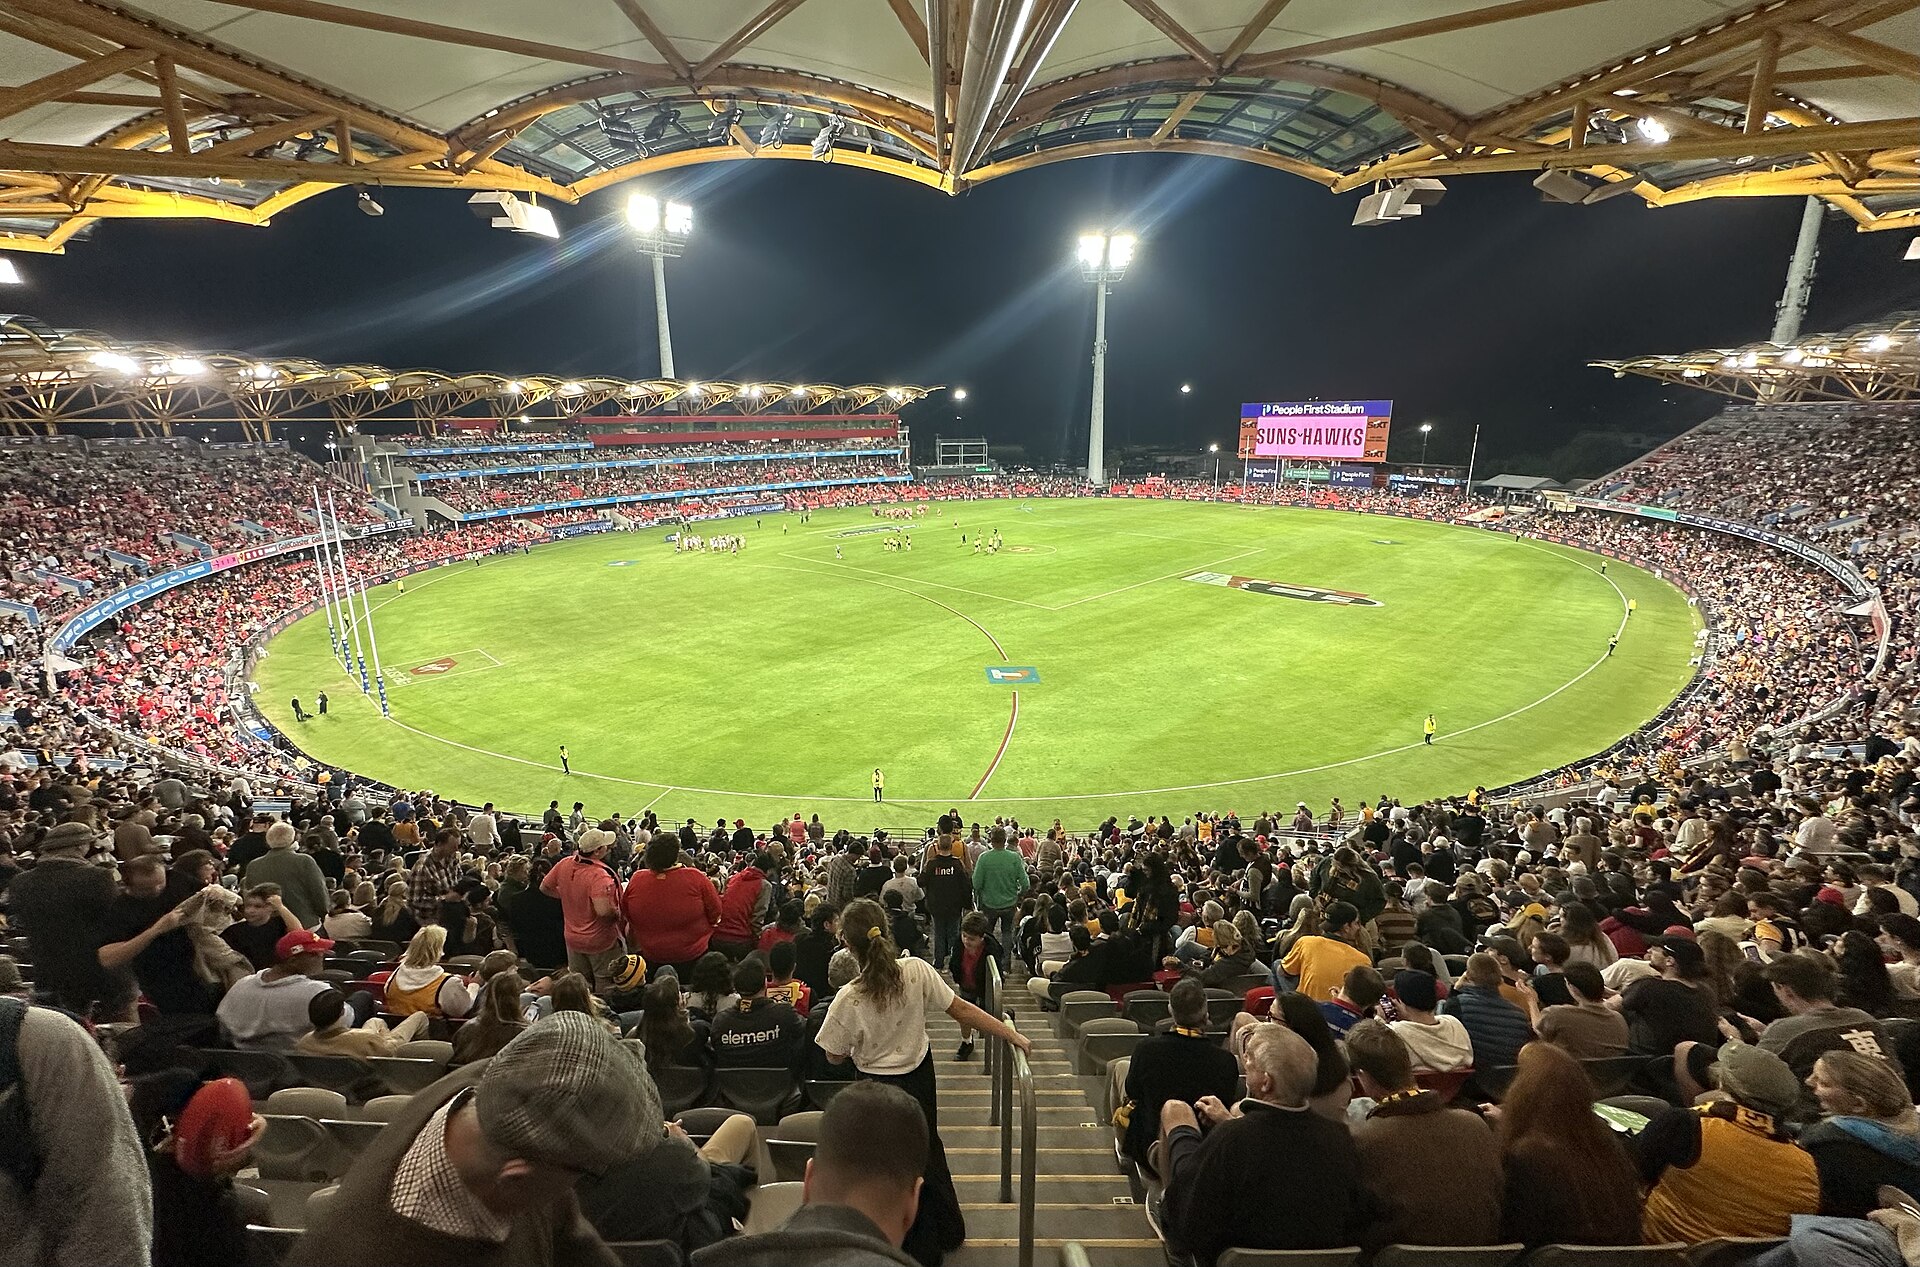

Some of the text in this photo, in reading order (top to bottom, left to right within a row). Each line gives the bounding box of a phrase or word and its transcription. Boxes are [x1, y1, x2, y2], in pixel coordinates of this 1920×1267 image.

[1272, 404, 1364, 416] People First Stadium
[1257, 428, 1297, 444] SUNS
[1303, 428, 1364, 446] HAWKS
[721, 1025, 780, 1044] element
